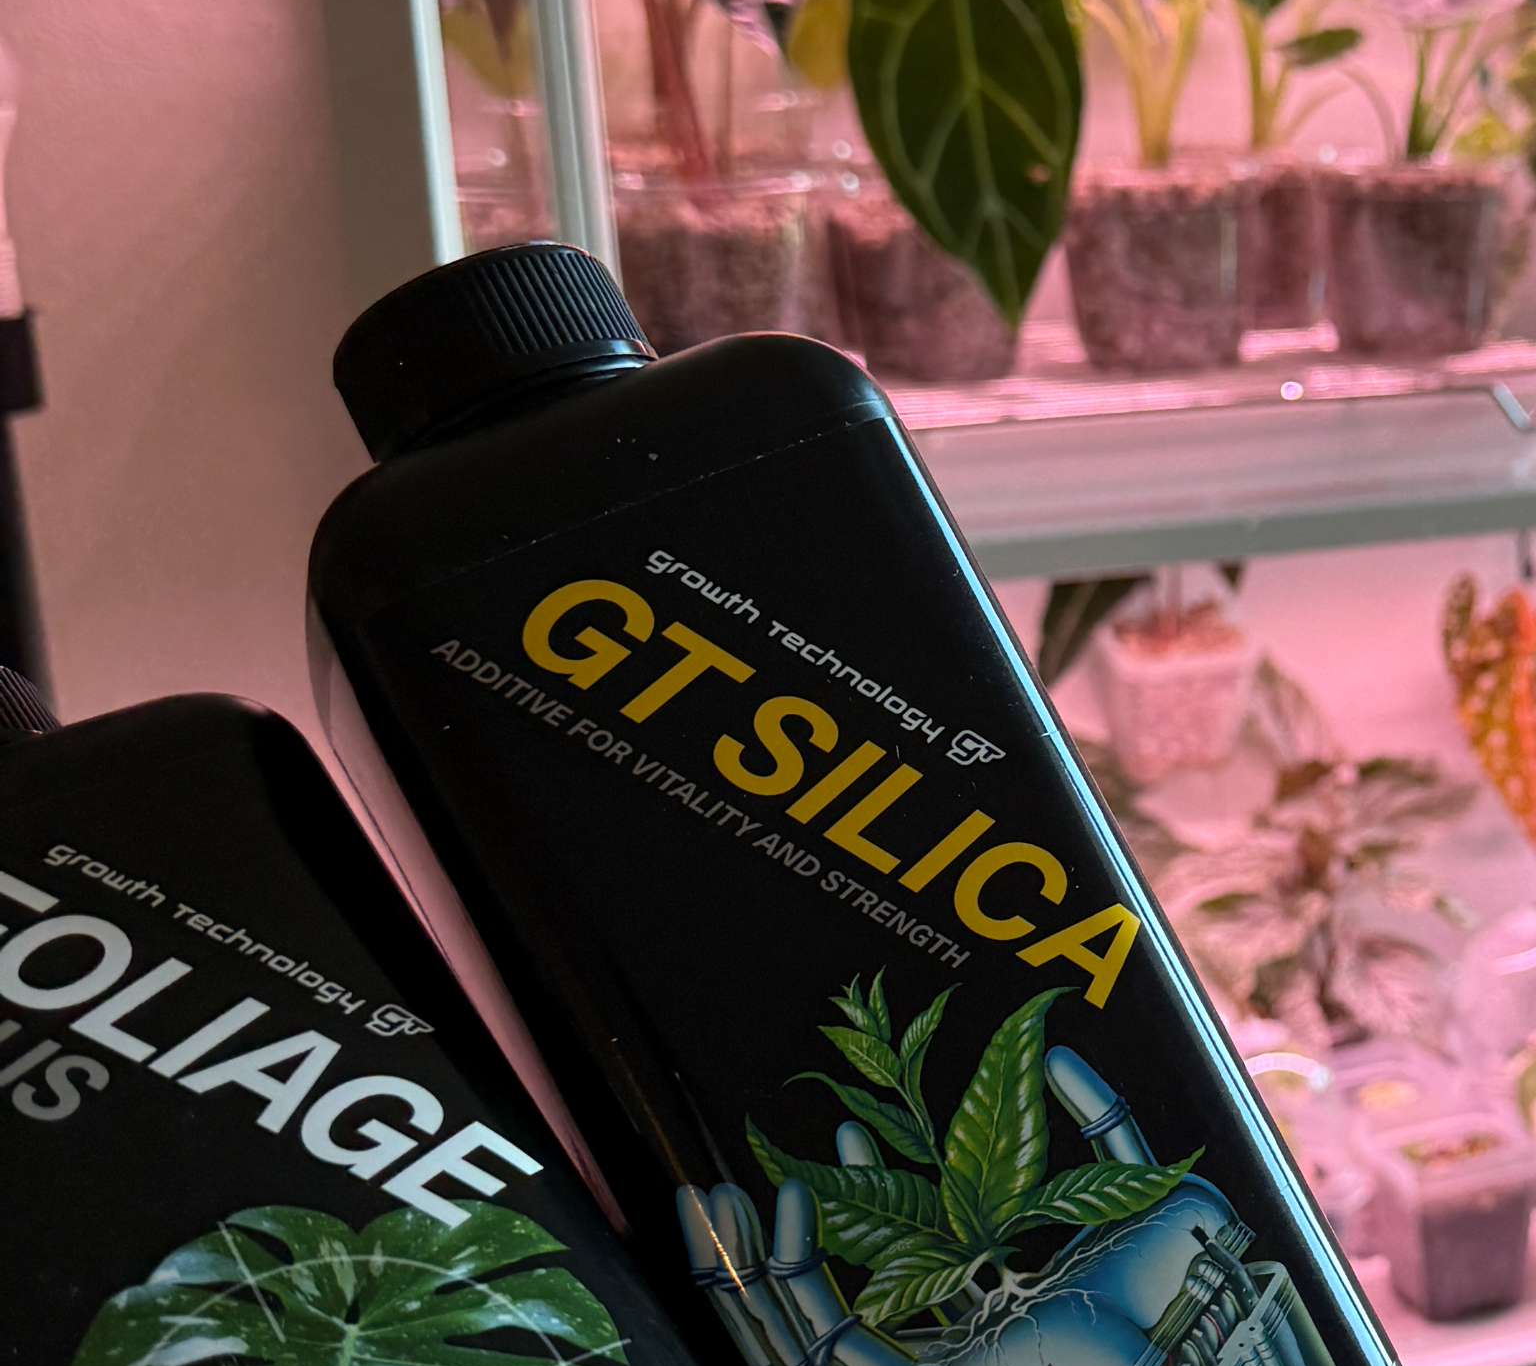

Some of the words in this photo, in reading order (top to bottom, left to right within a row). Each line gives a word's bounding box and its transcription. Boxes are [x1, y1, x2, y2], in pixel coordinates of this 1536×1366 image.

[644, 549, 761, 624] growth
[43, 844, 166, 908] growth
[430, 638, 574, 728] ADDITIVE
[566, 718, 634, 765] FOR
[632, 753, 764, 837] VITALITY
[752, 832, 821, 877] AND
[819, 870, 971, 969] STRENGTH
[521, 578, 757, 725] GT
[712, 695, 1142, 1010] SILICA
